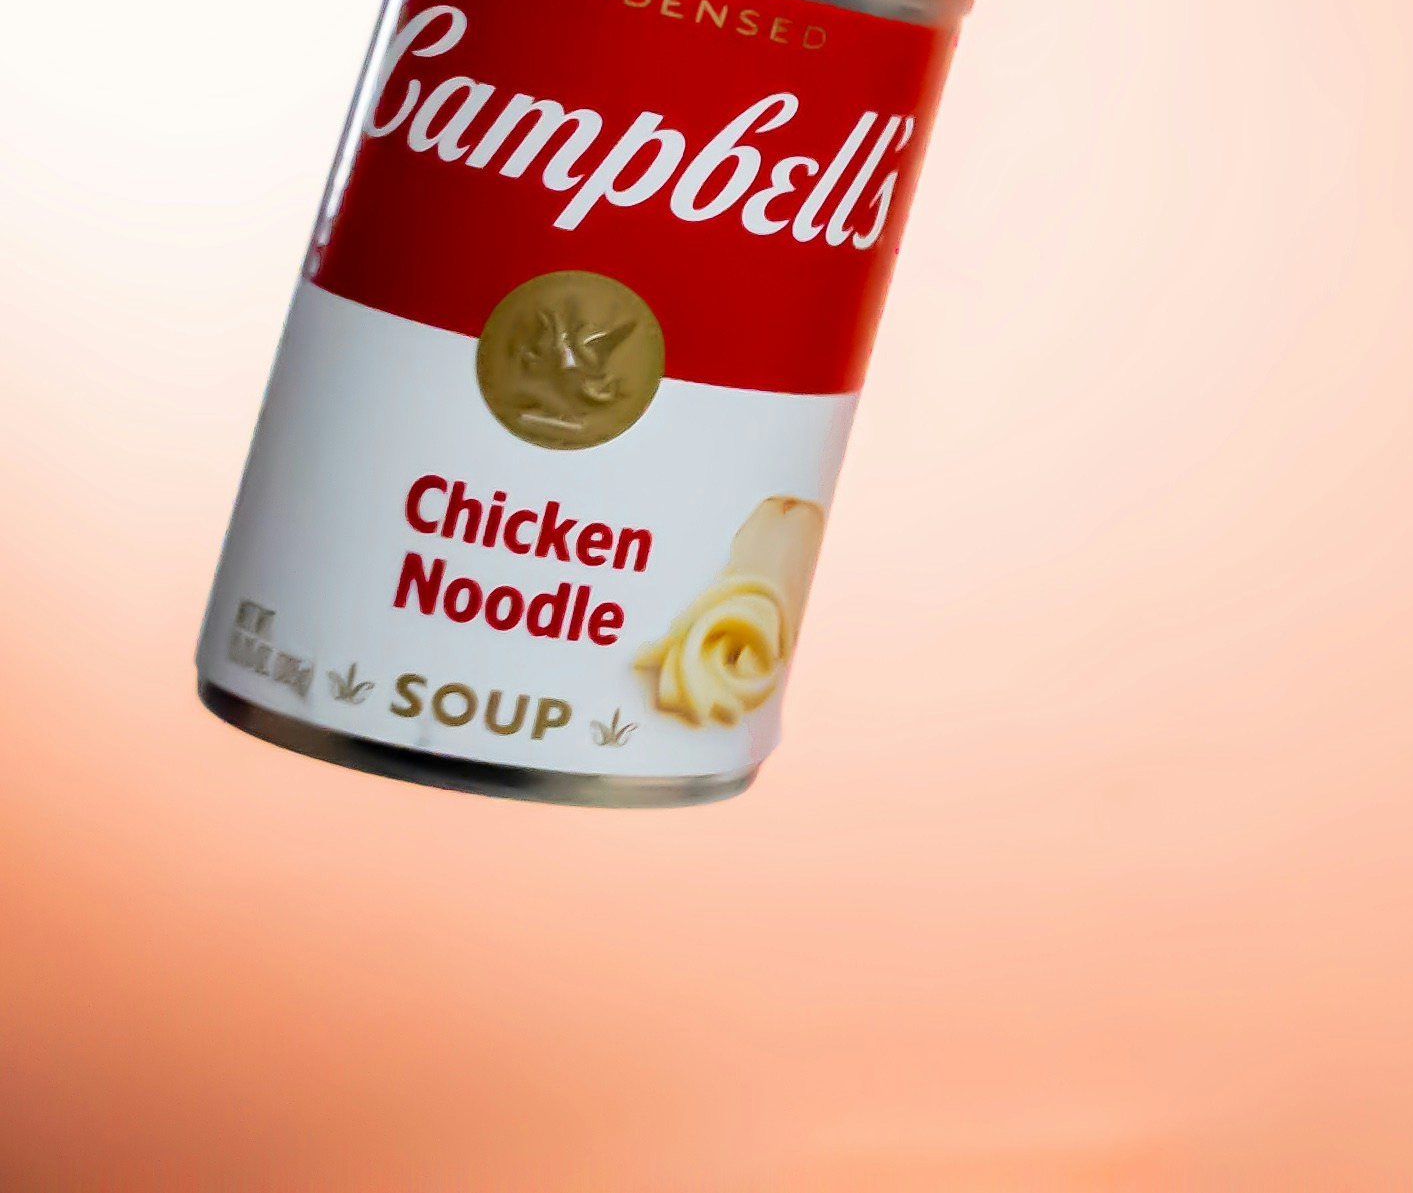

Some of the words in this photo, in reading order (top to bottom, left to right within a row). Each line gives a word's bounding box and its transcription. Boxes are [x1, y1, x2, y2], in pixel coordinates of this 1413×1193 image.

[363, 4, 915, 250] Campbell's
[405, 475, 653, 573] Chicken
[394, 553, 625, 646] Noodle
[389, 673, 574, 741] SOUP
